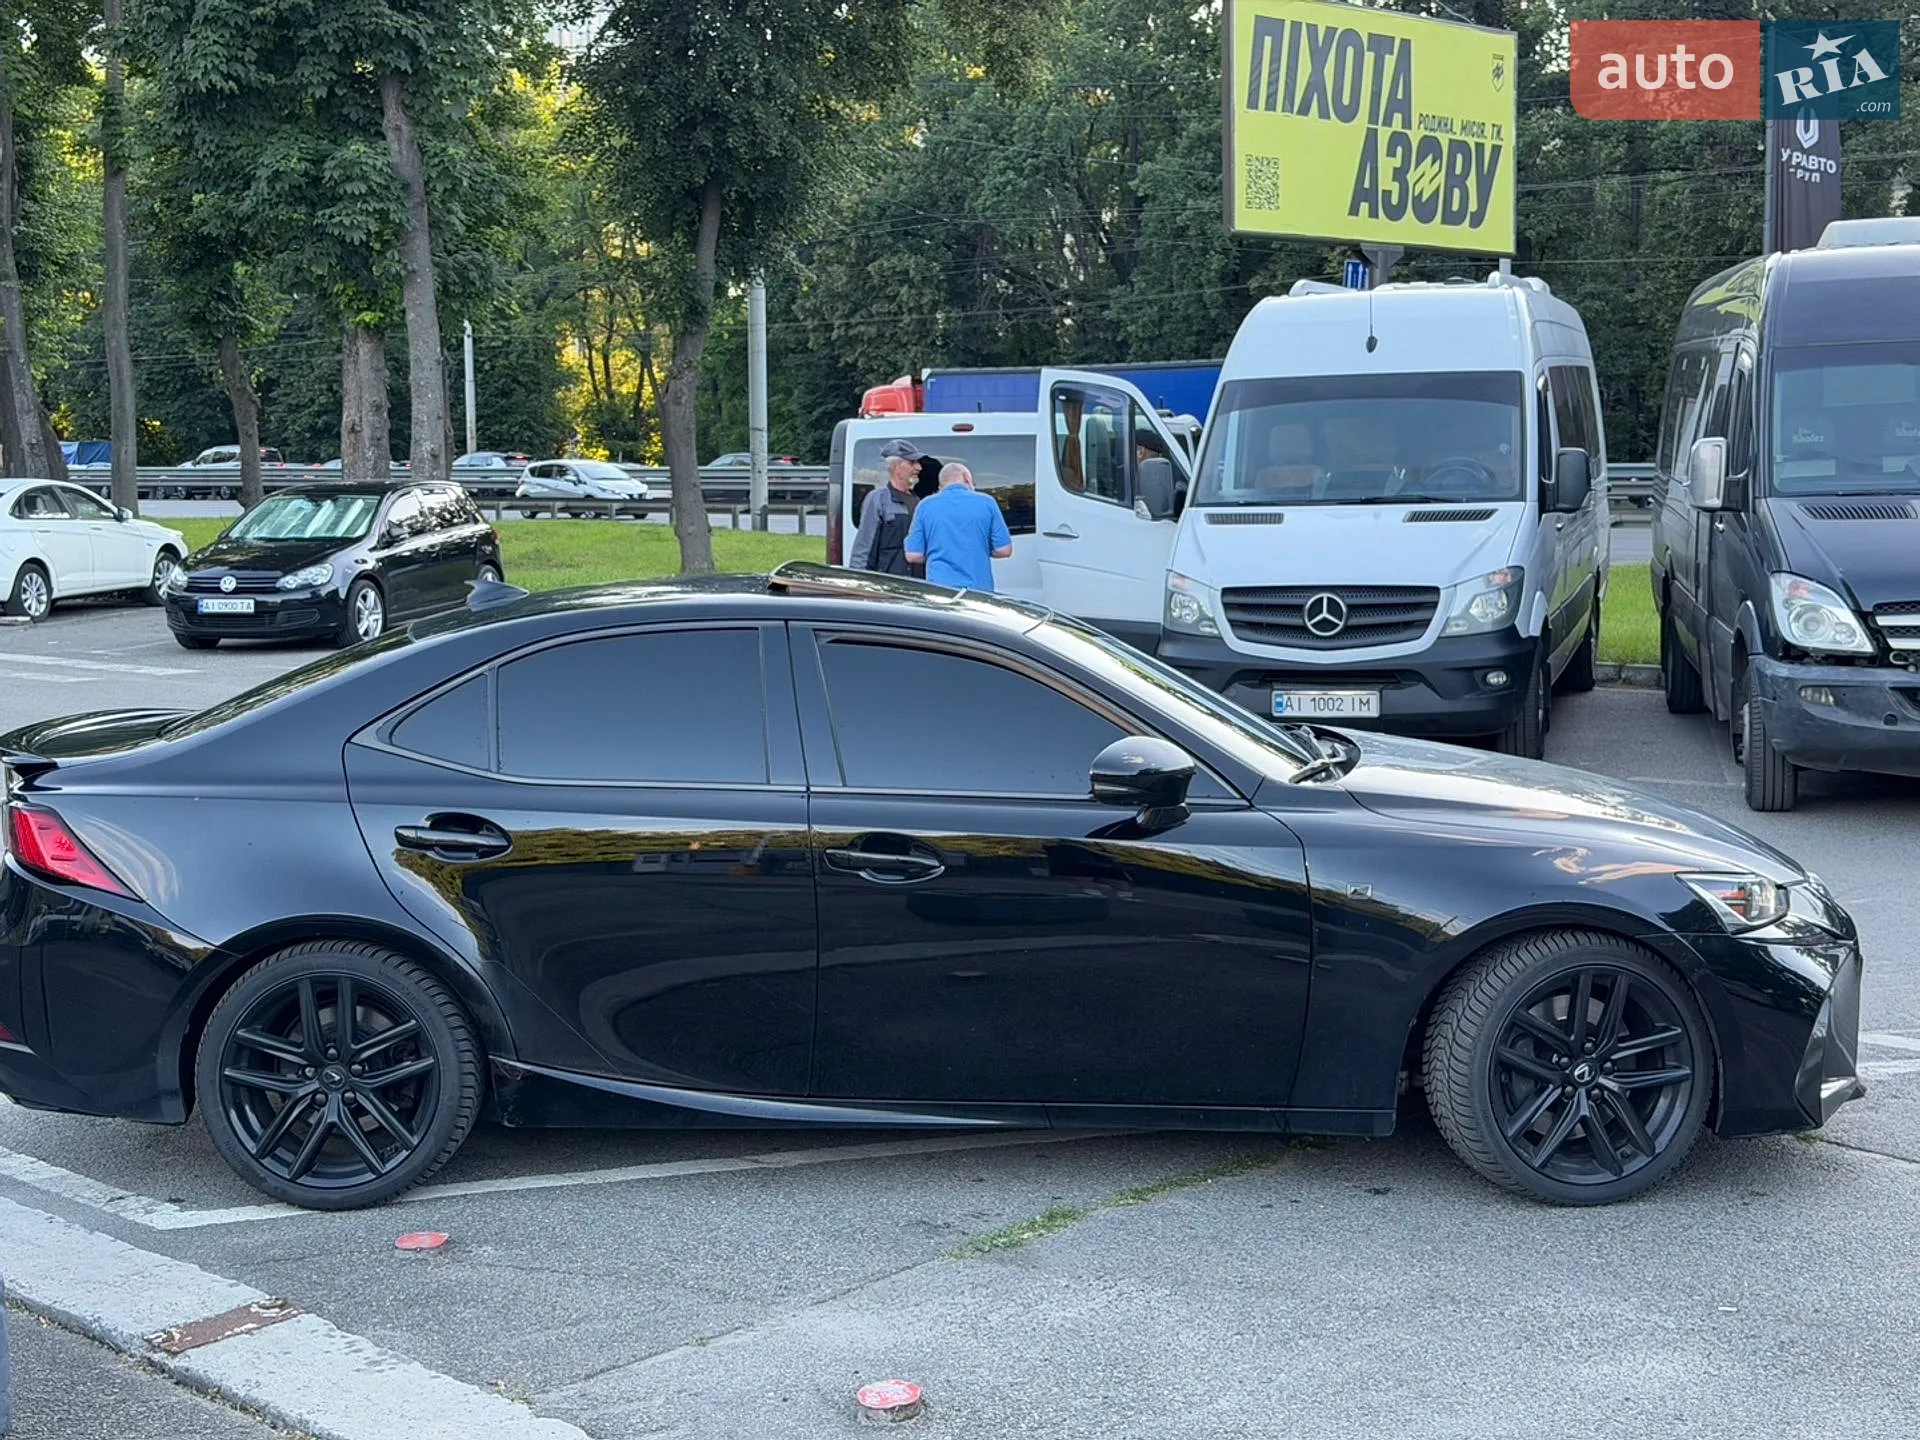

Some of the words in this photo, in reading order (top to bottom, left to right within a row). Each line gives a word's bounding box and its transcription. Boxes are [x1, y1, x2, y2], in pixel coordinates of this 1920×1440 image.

[1246, 14, 1412, 130] ПІХОТА
[1348, 126, 1503, 229] АЗОВУ
[1284, 696, 1302, 711] AI
[1310, 697, 1344, 712] 1002
[1351, 697, 1371, 711] IM
